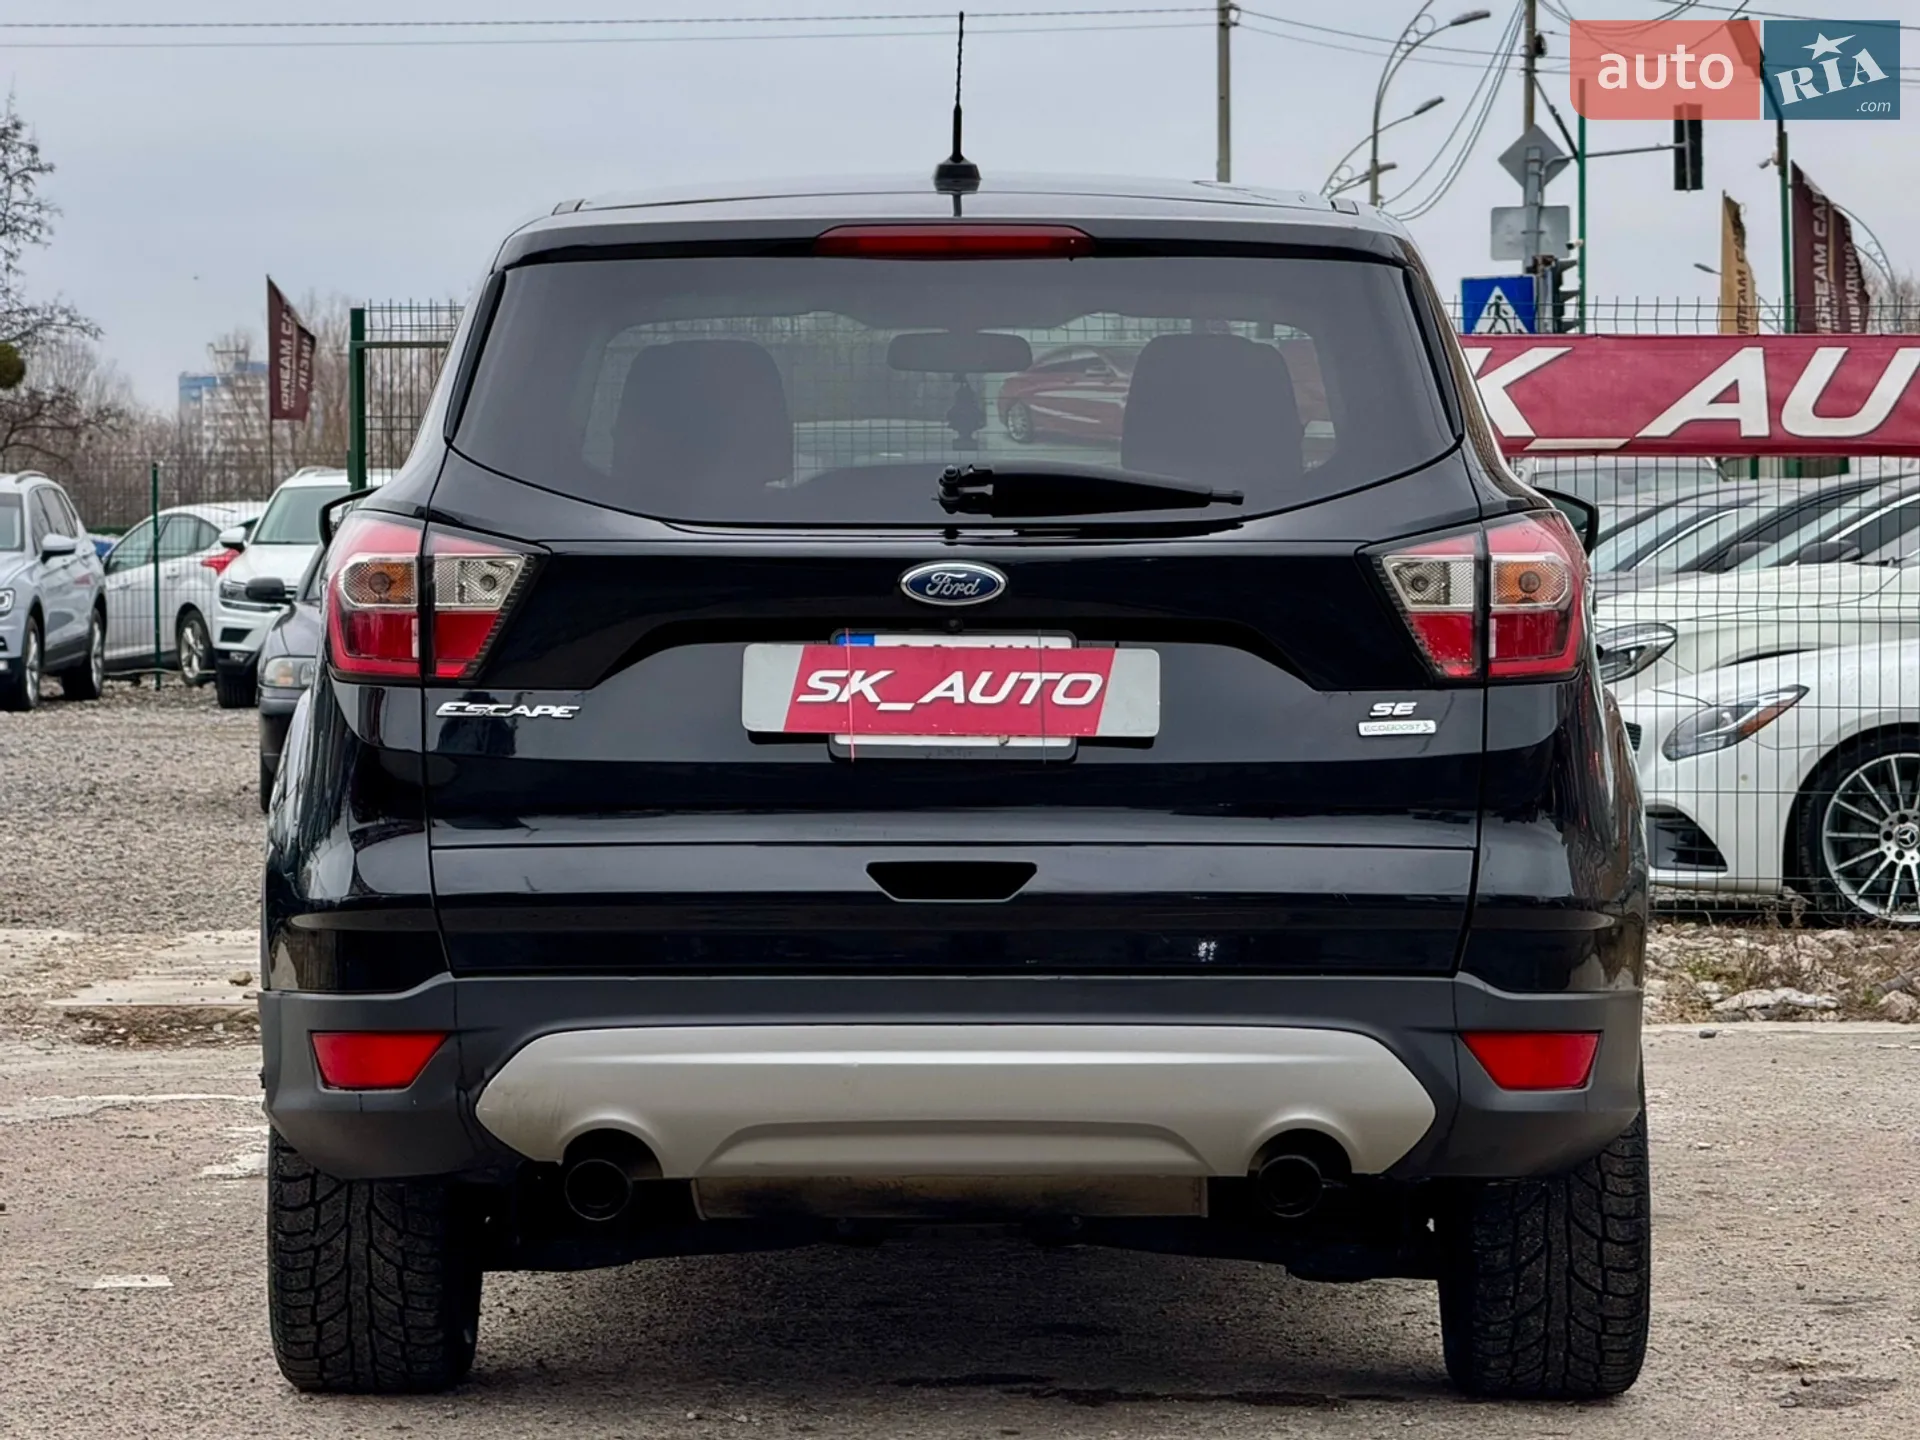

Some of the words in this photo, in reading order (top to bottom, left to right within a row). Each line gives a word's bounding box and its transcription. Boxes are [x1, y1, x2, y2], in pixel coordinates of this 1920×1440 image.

[925, 571, 981, 597] Ford
[796, 669, 1103, 711] SK_AUTO
[435, 701, 581, 718] ESCAPE
[1369, 701, 1418, 716] SE
